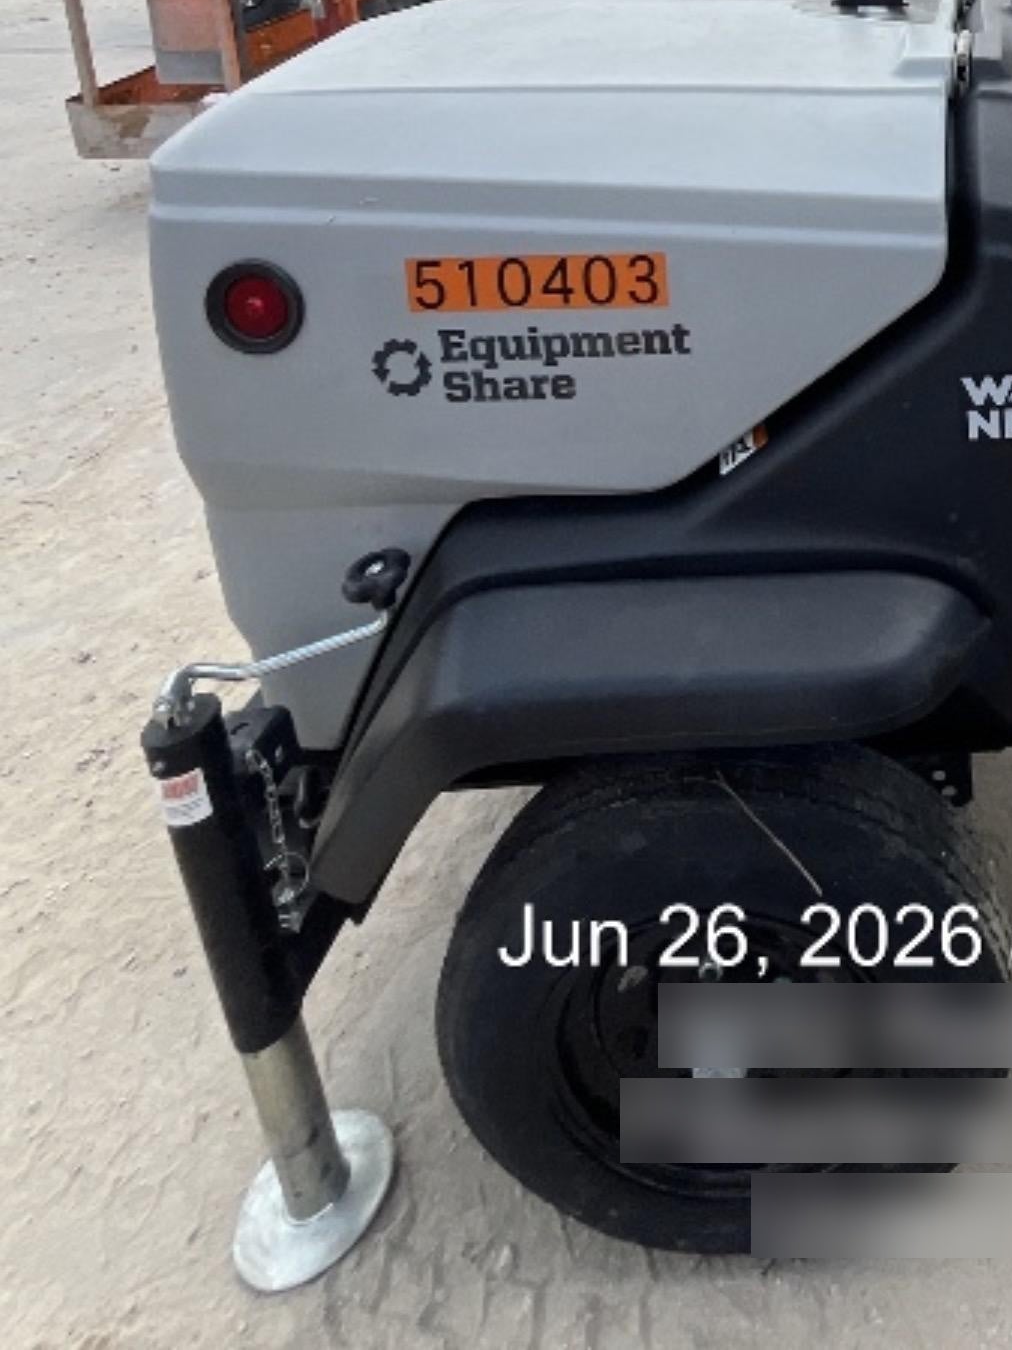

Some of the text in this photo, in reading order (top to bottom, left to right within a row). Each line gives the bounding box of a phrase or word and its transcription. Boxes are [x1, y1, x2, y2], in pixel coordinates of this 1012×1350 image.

[414, 254, 661, 310] 510403
[436, 323, 692, 370] Equipment
[443, 368, 577, 403] Share
